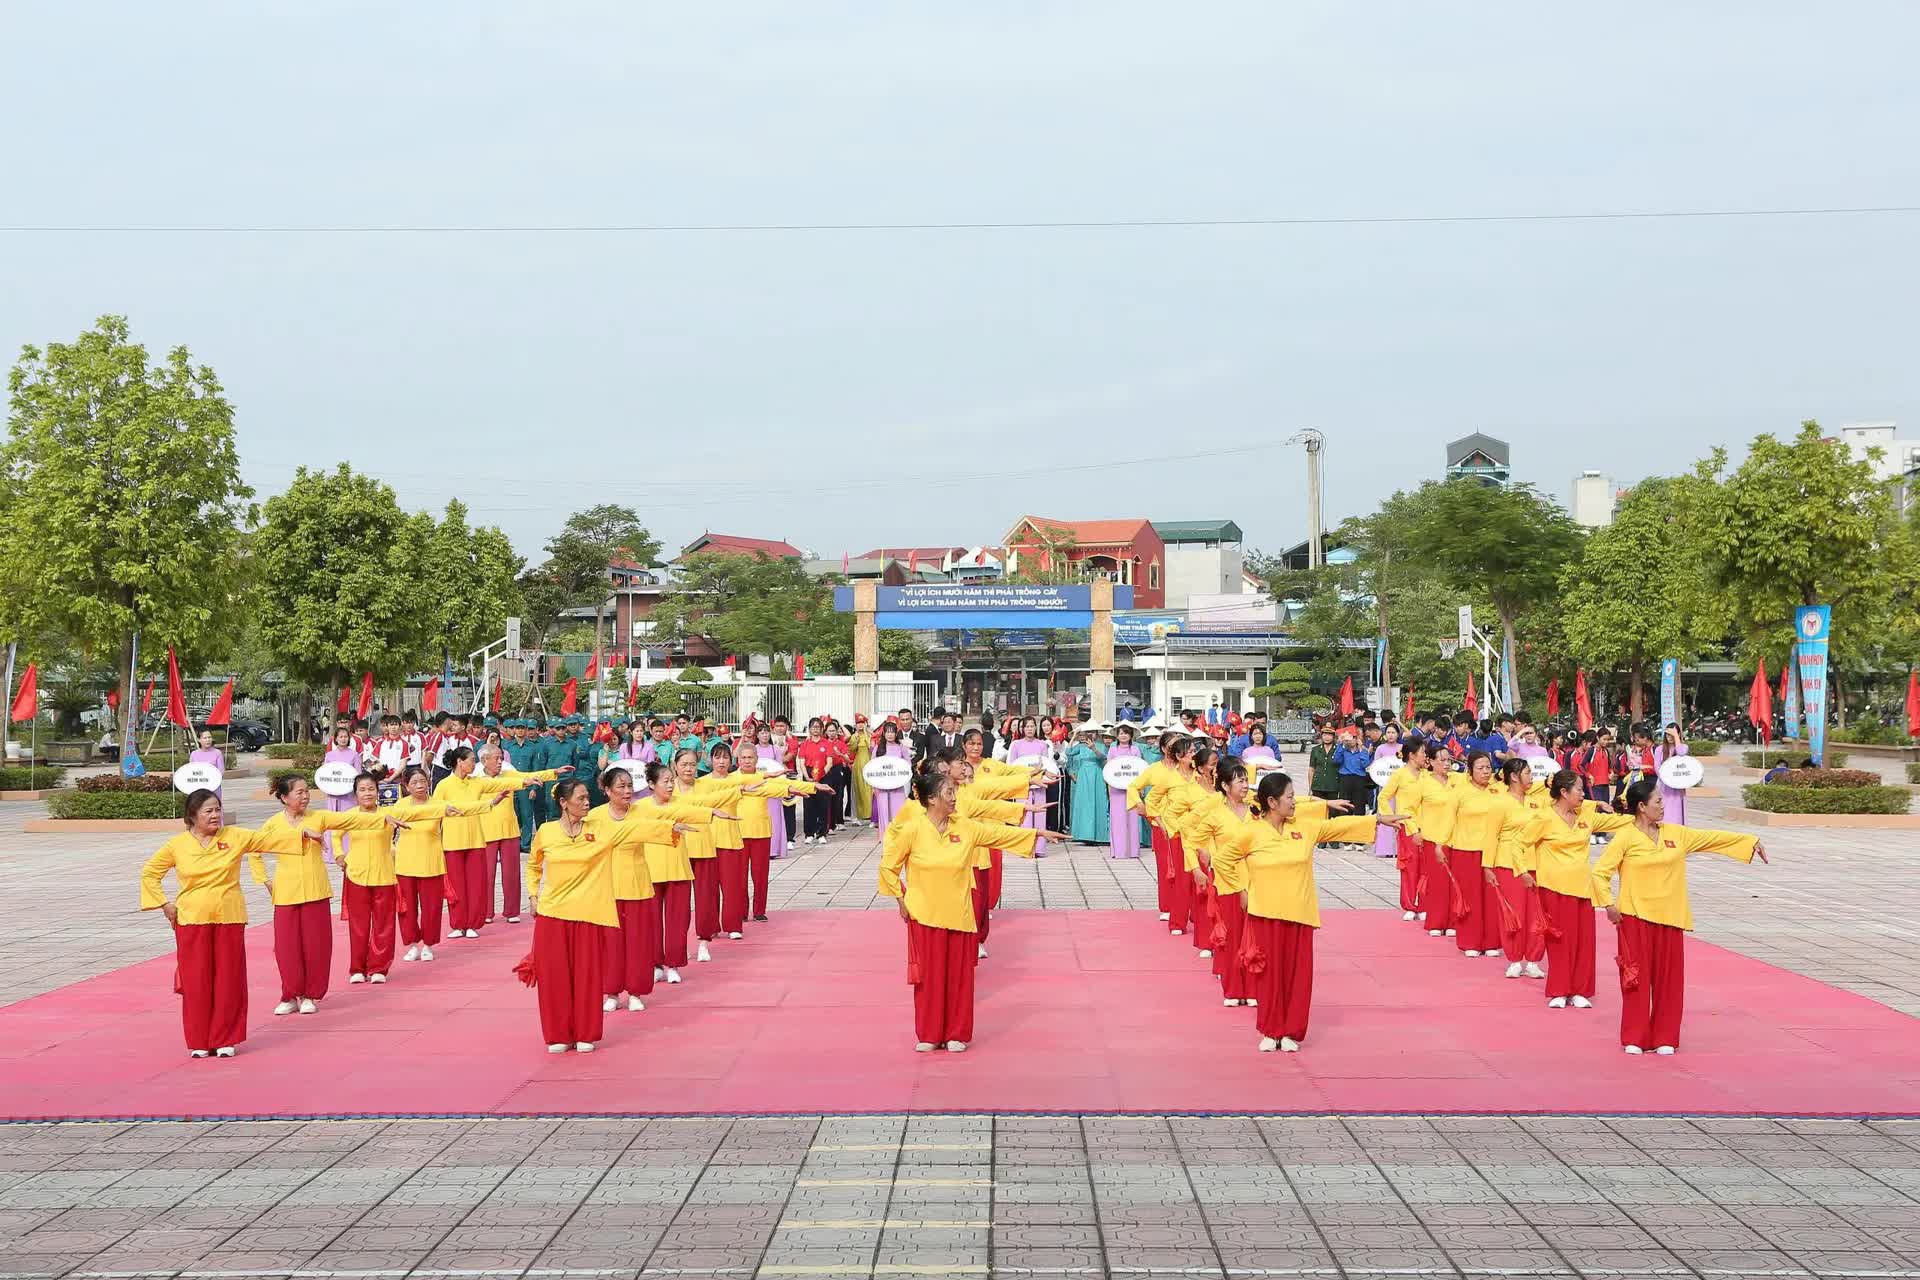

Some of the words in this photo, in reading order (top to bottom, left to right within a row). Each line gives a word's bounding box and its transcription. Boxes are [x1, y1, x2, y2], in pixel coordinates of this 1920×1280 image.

[914, 588, 926, 597] LỢI
[928, 587, 941, 596] ÍCH
[943, 587, 963, 596] MƯỜI
[964, 587, 982, 596] NĂM
[983, 587, 995, 596] THÌ
[996, 586, 1014, 596] PHẢI
[1015, 585, 1041, 596] TRỒNG
[1043, 587, 1058, 596] CÂY
[897, 597, 906, 606] VÌ
[907, 598, 919, 608] LỢI
[920, 597, 934, 606] ÍCH
[936, 597, 957, 606] TRĂM
[958, 597, 977, 606] NĂM
[978, 597, 989, 606] THÌ
[990, 597, 1009, 606] PHẢI
[1010, 595, 1036, 606] TRỒNG
